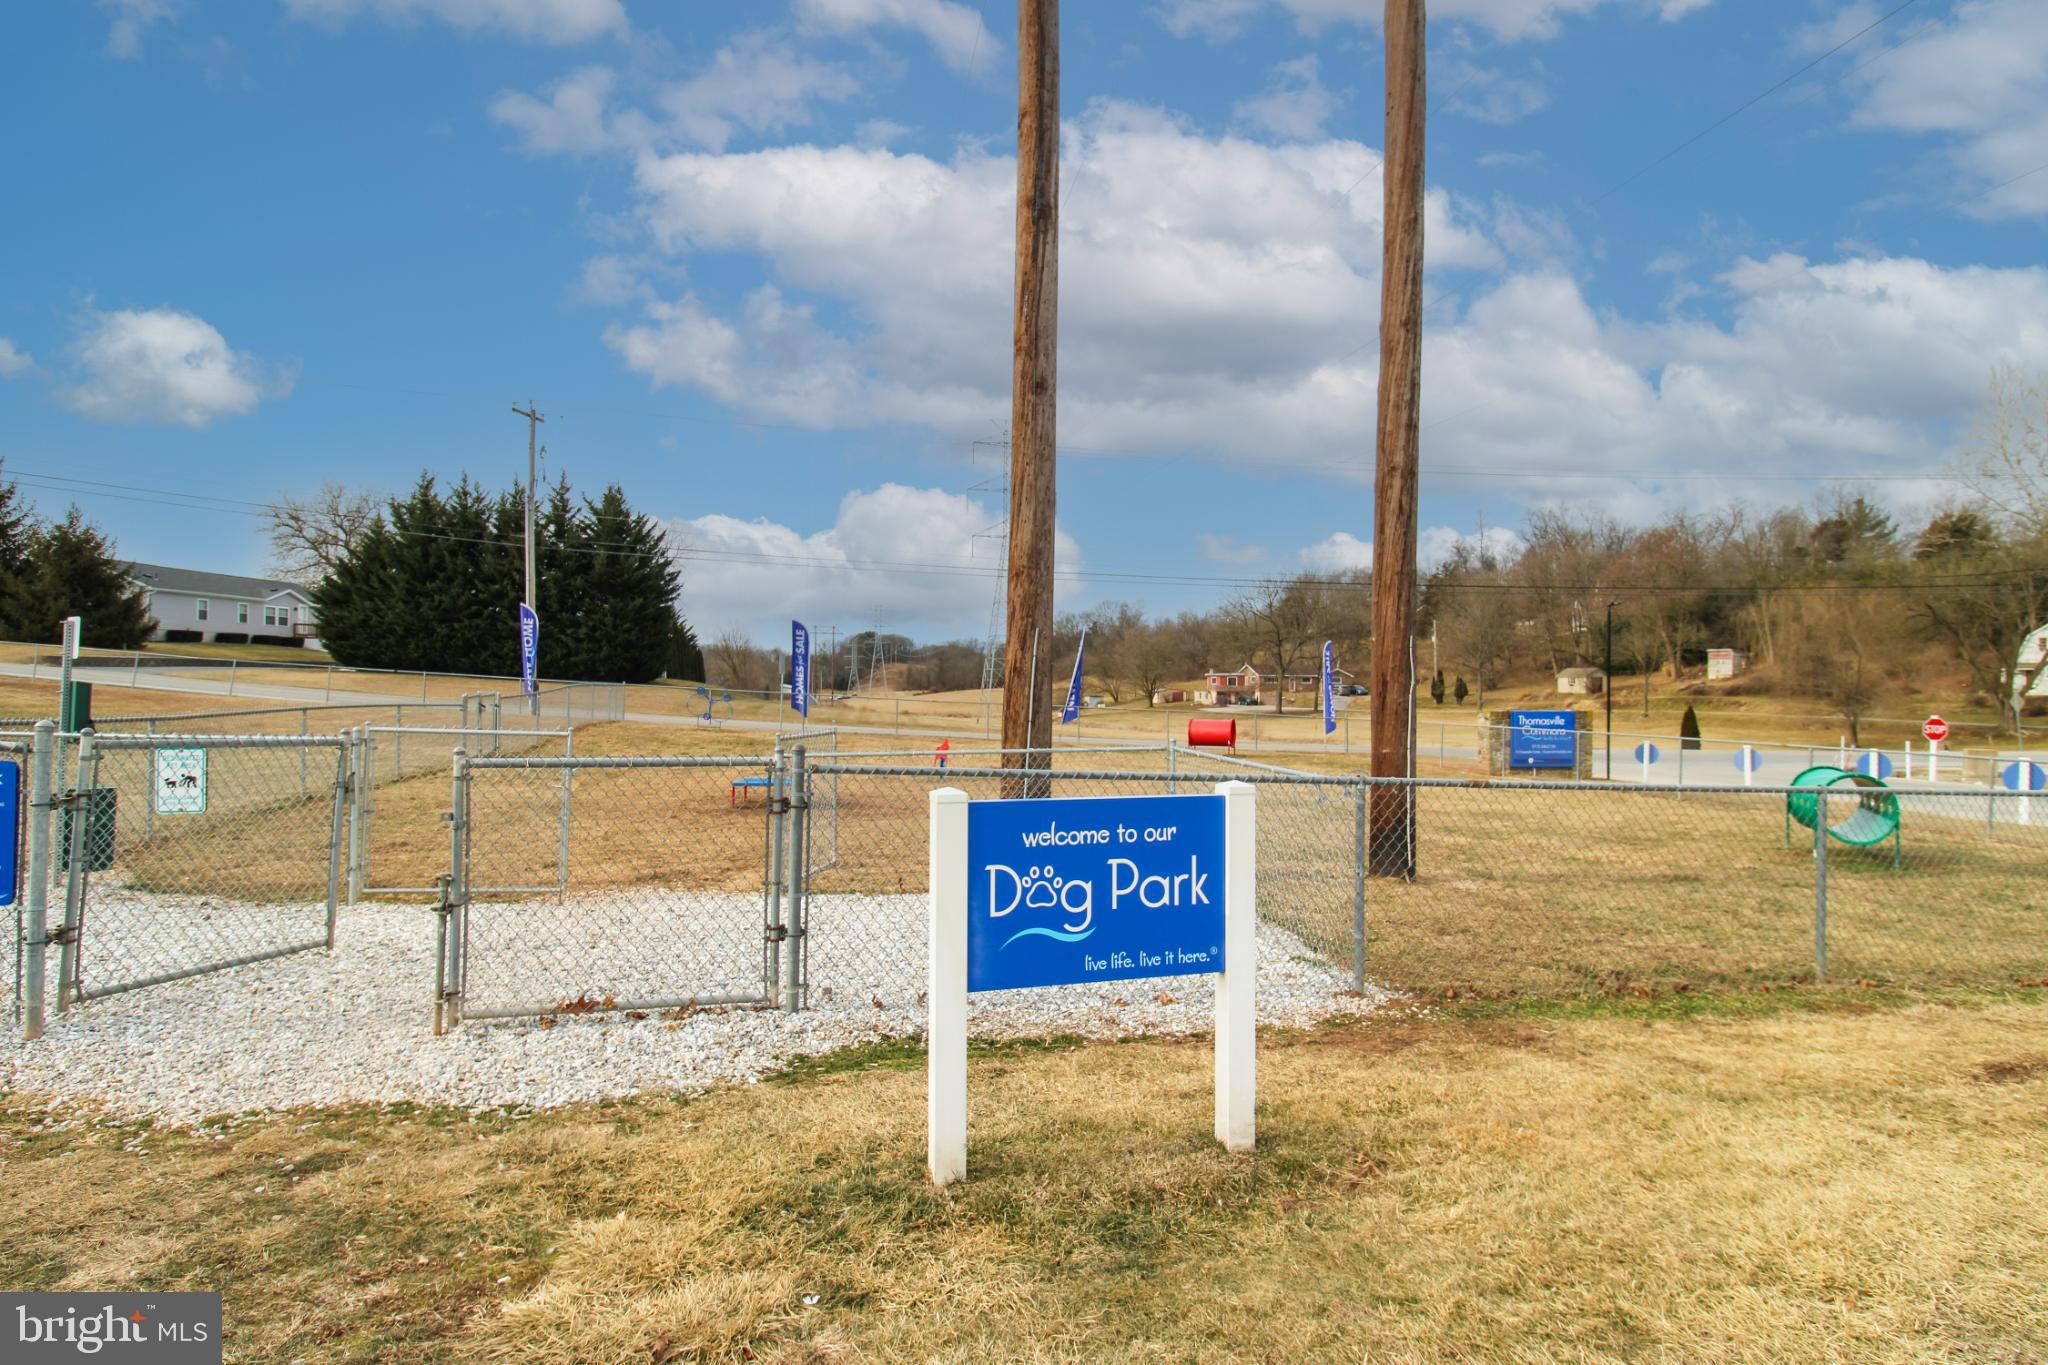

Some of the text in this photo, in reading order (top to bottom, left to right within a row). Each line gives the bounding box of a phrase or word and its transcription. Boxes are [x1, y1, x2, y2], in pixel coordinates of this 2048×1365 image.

[523, 618, 534, 657] HOME
[795, 629, 805, 654] SALE
[795, 666, 804, 705] HOMES
[1518, 715, 1565, 725] Thomasville
[1521, 726, 1566, 736] Commons
[1924, 725, 1947, 734] STOP
[1022, 821, 1177, 848] welcome to our
[985, 855, 1210, 932] Dog Park
[1085, 955, 1107, 971] live
[1111, 952, 1135, 968] life.
[1140, 951, 1161, 967] live
[1165, 950, 1174, 965] it
